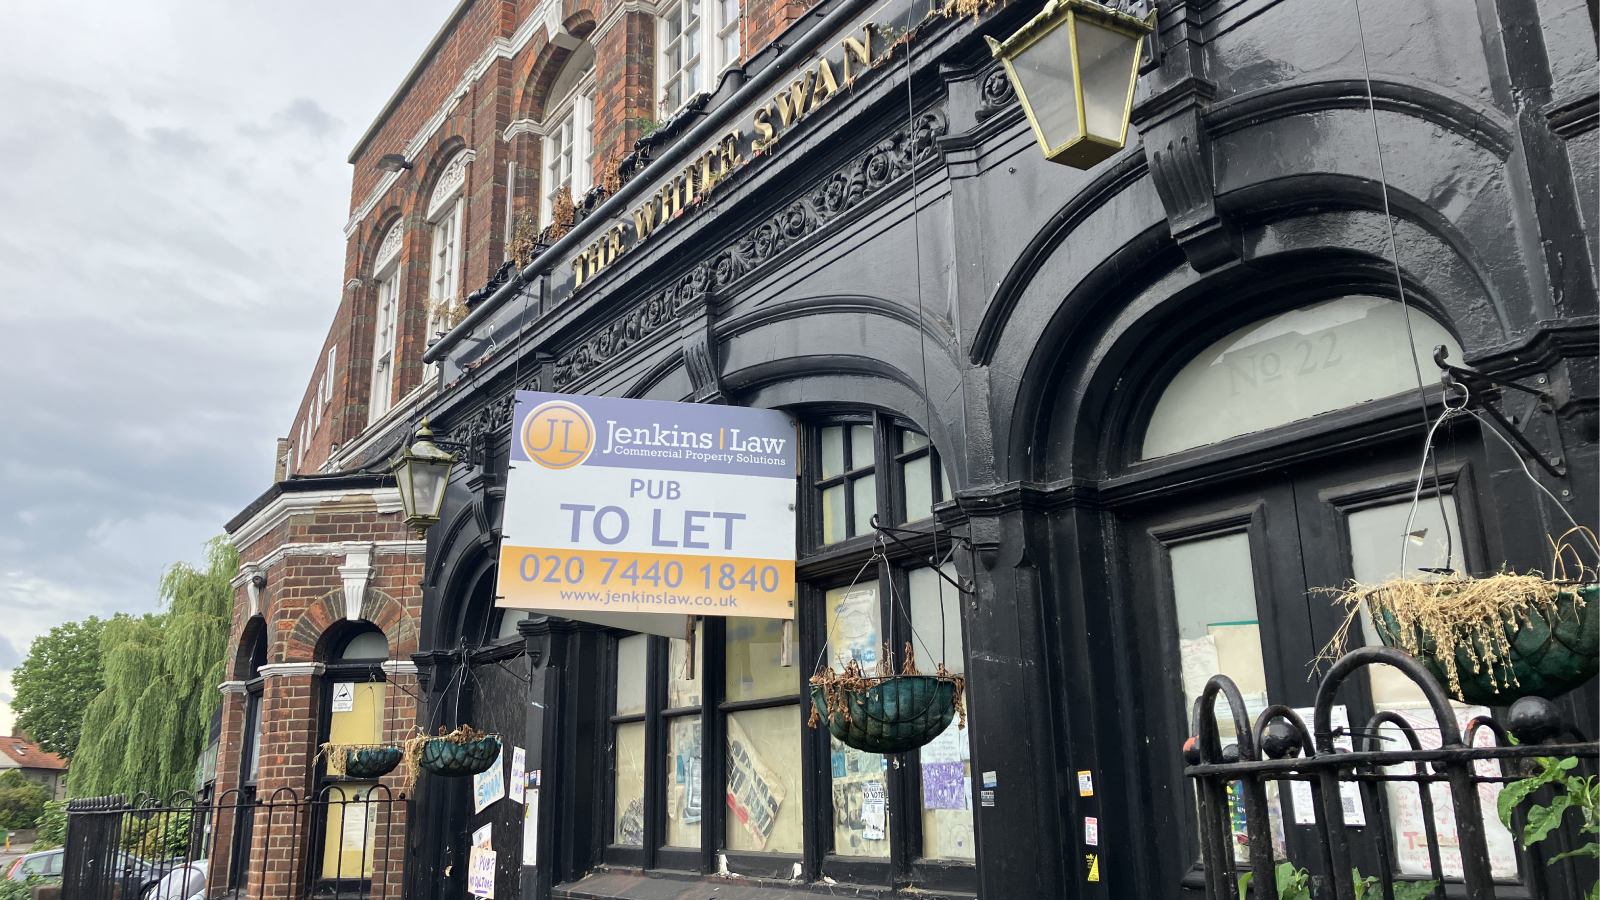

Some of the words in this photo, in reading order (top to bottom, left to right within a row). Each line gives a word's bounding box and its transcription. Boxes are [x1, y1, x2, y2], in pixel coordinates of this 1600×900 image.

[571, 223, 626, 291] THE
[631, 129, 741, 241] WHITE
[752, 21, 874, 153] SWAN
[1295, 331, 1343, 376] 22
[603, 420, 713, 454] Jenkins
[730, 429, 786, 454] Law
[614, 445, 683, 460] Commercial
[685, 449, 733, 463] Property
[736, 453, 786, 466] Solutions
[630, 478, 681, 500] PUB
[560, 503, 630, 545] TO
[651, 508, 747, 550] LET
[519, 553, 585, 584] 020
[599, 557, 684, 589] 7440
[700, 562, 780, 593] 1840
[560, 590, 738, 608] www.jenkinslaw.co.uk
